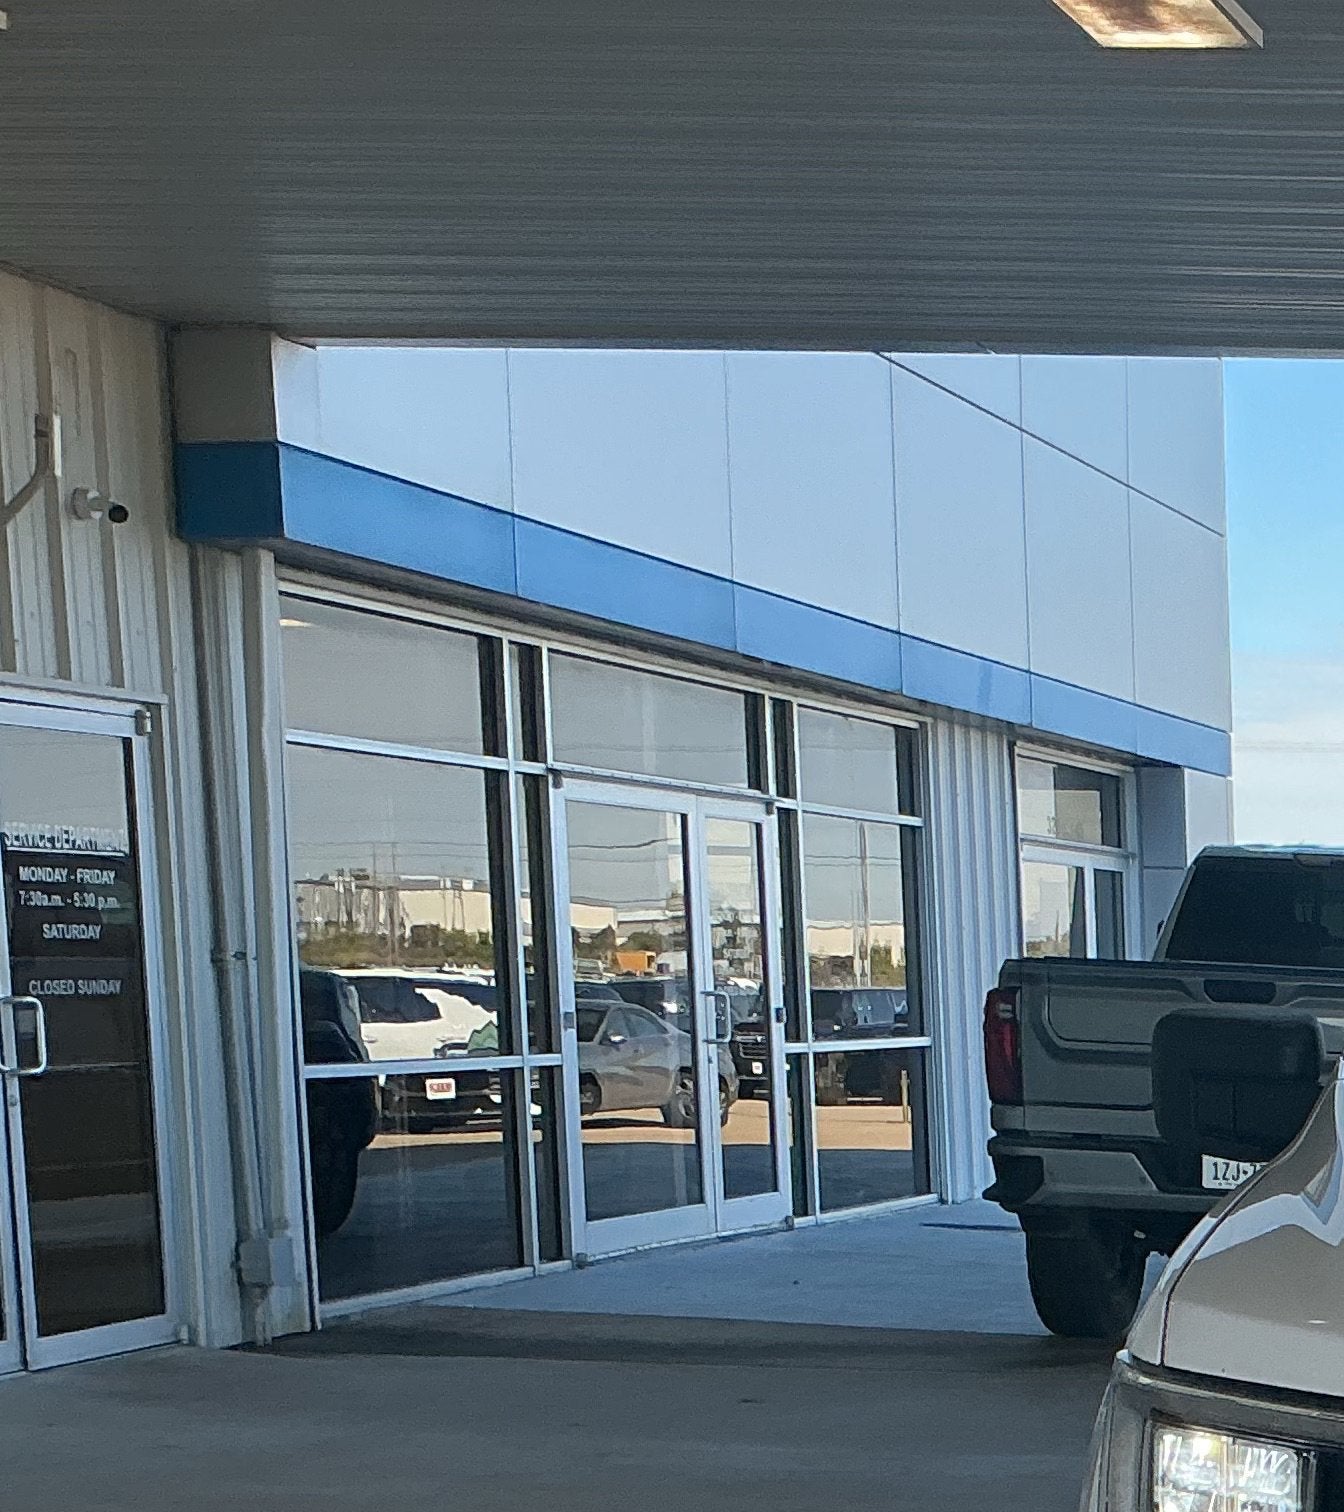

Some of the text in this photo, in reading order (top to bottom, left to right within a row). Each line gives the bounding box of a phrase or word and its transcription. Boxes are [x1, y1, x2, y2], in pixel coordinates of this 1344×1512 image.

[19, 866, 68, 883] MONDAY
[77, 868, 116, 885] FRIDAY
[42, 923, 101, 939] SATURDAY
[29, 979, 122, 995] CLOSED SUNDAY
